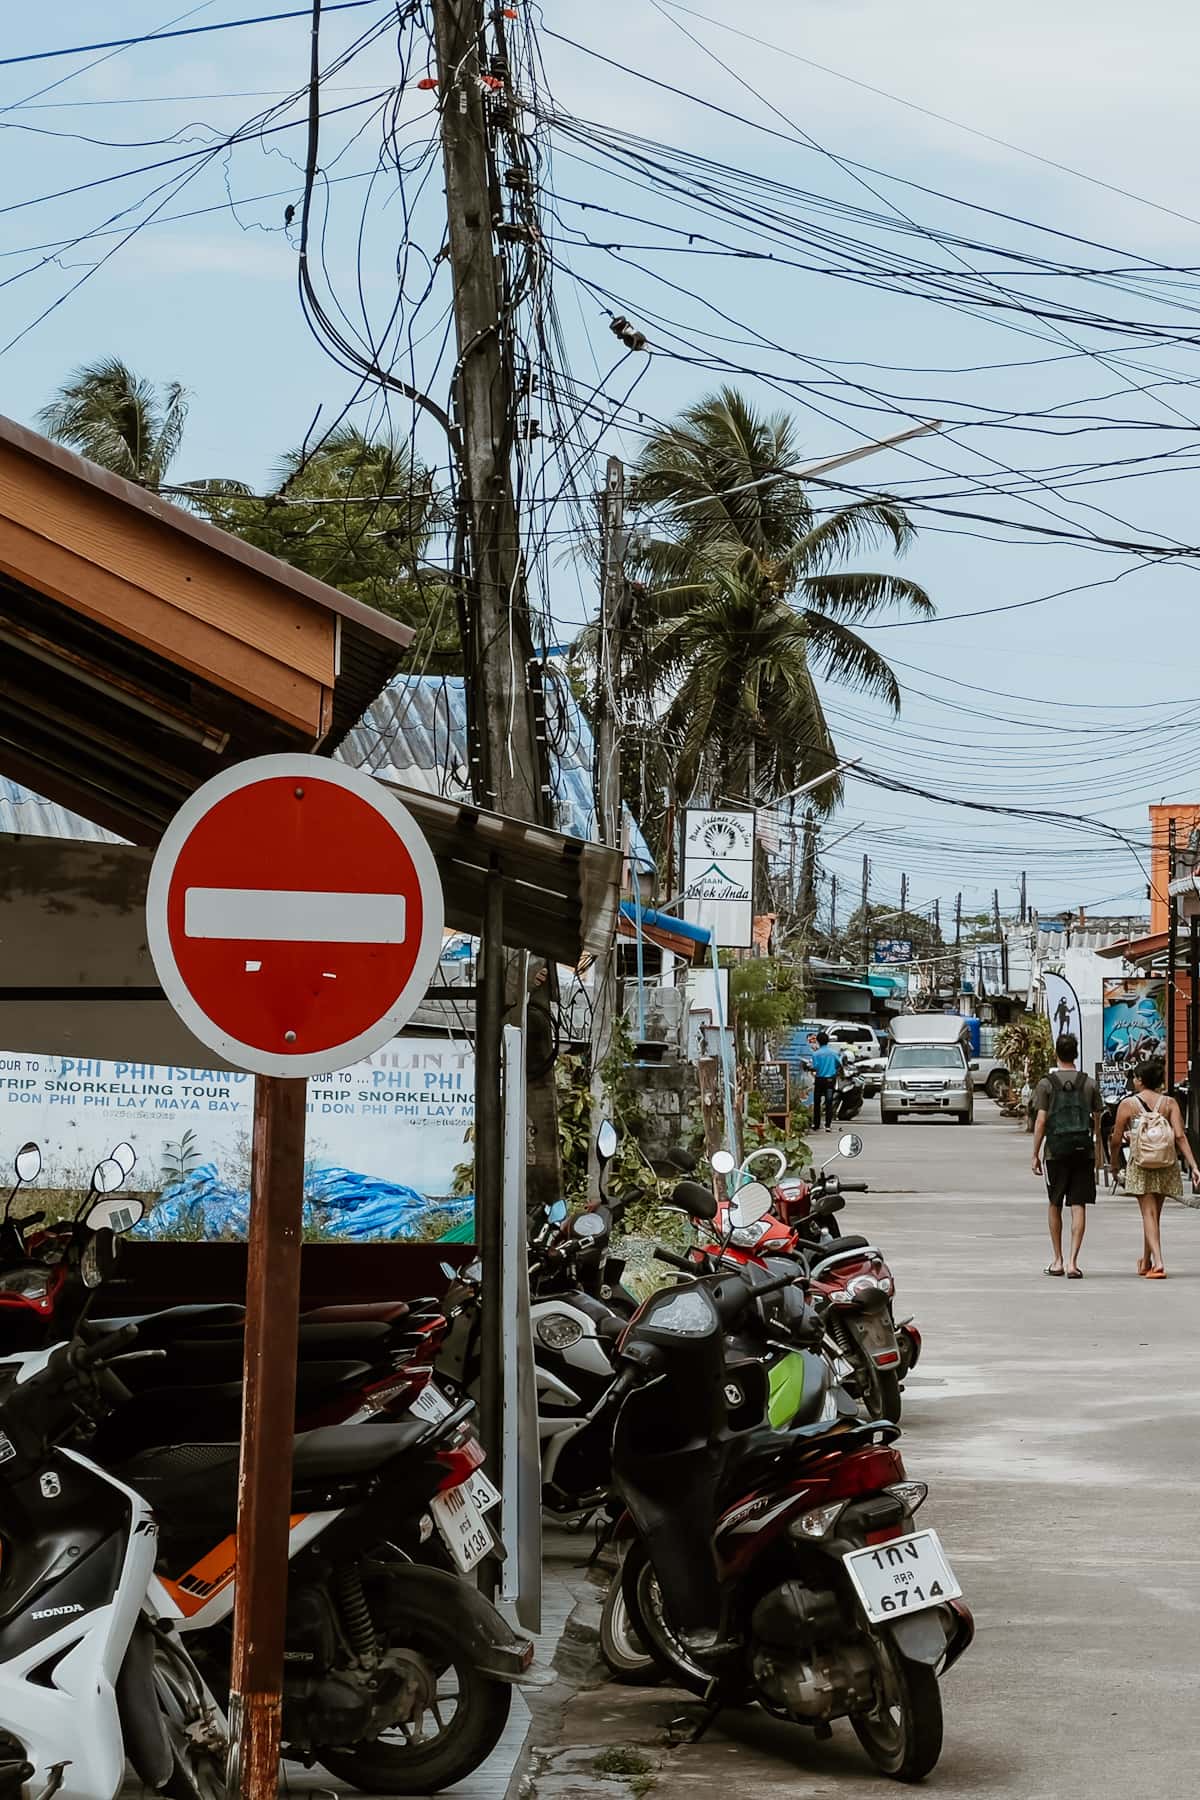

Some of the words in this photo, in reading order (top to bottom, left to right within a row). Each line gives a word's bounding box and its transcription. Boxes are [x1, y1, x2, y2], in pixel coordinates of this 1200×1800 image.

[718, 885, 750, 899] Anda
[26, 1061, 39, 1072] TO
[59, 1057, 101, 1078] PHI
[113, 1062, 156, 1080] PHI
[167, 1067, 248, 1084] ISLAND
[310, 1072, 334, 1084] OUR
[338, 1073, 352, 1083] TO
[372, 1070, 411, 1088] PHI
[424, 1072, 463, 1089] PHI
[44, 1080, 173, 1096] SNORKELLING
[181, 1086, 231, 1098] TOUR
[311, 1090, 351, 1101] TRIP
[7, 1092, 43, 1104] DON
[49, 1093, 76, 1105] PHI
[83, 1095, 110, 1107] PHI
[116, 1097, 148, 1109] LAY
[154, 1098, 201, 1110] MAYA
[207, 1100, 240, 1112] BAY
[321, 1103, 355, 1114] DON
[361, 1104, 387, 1115] PHI
[394, 1105, 419, 1116] PHI
[426, 1105, 455, 1117] LAY
[462, 1528, 487, 1561] 4138
[880, 1580, 944, 1612] 6714
[31, 1603, 85, 1620] HONDA
